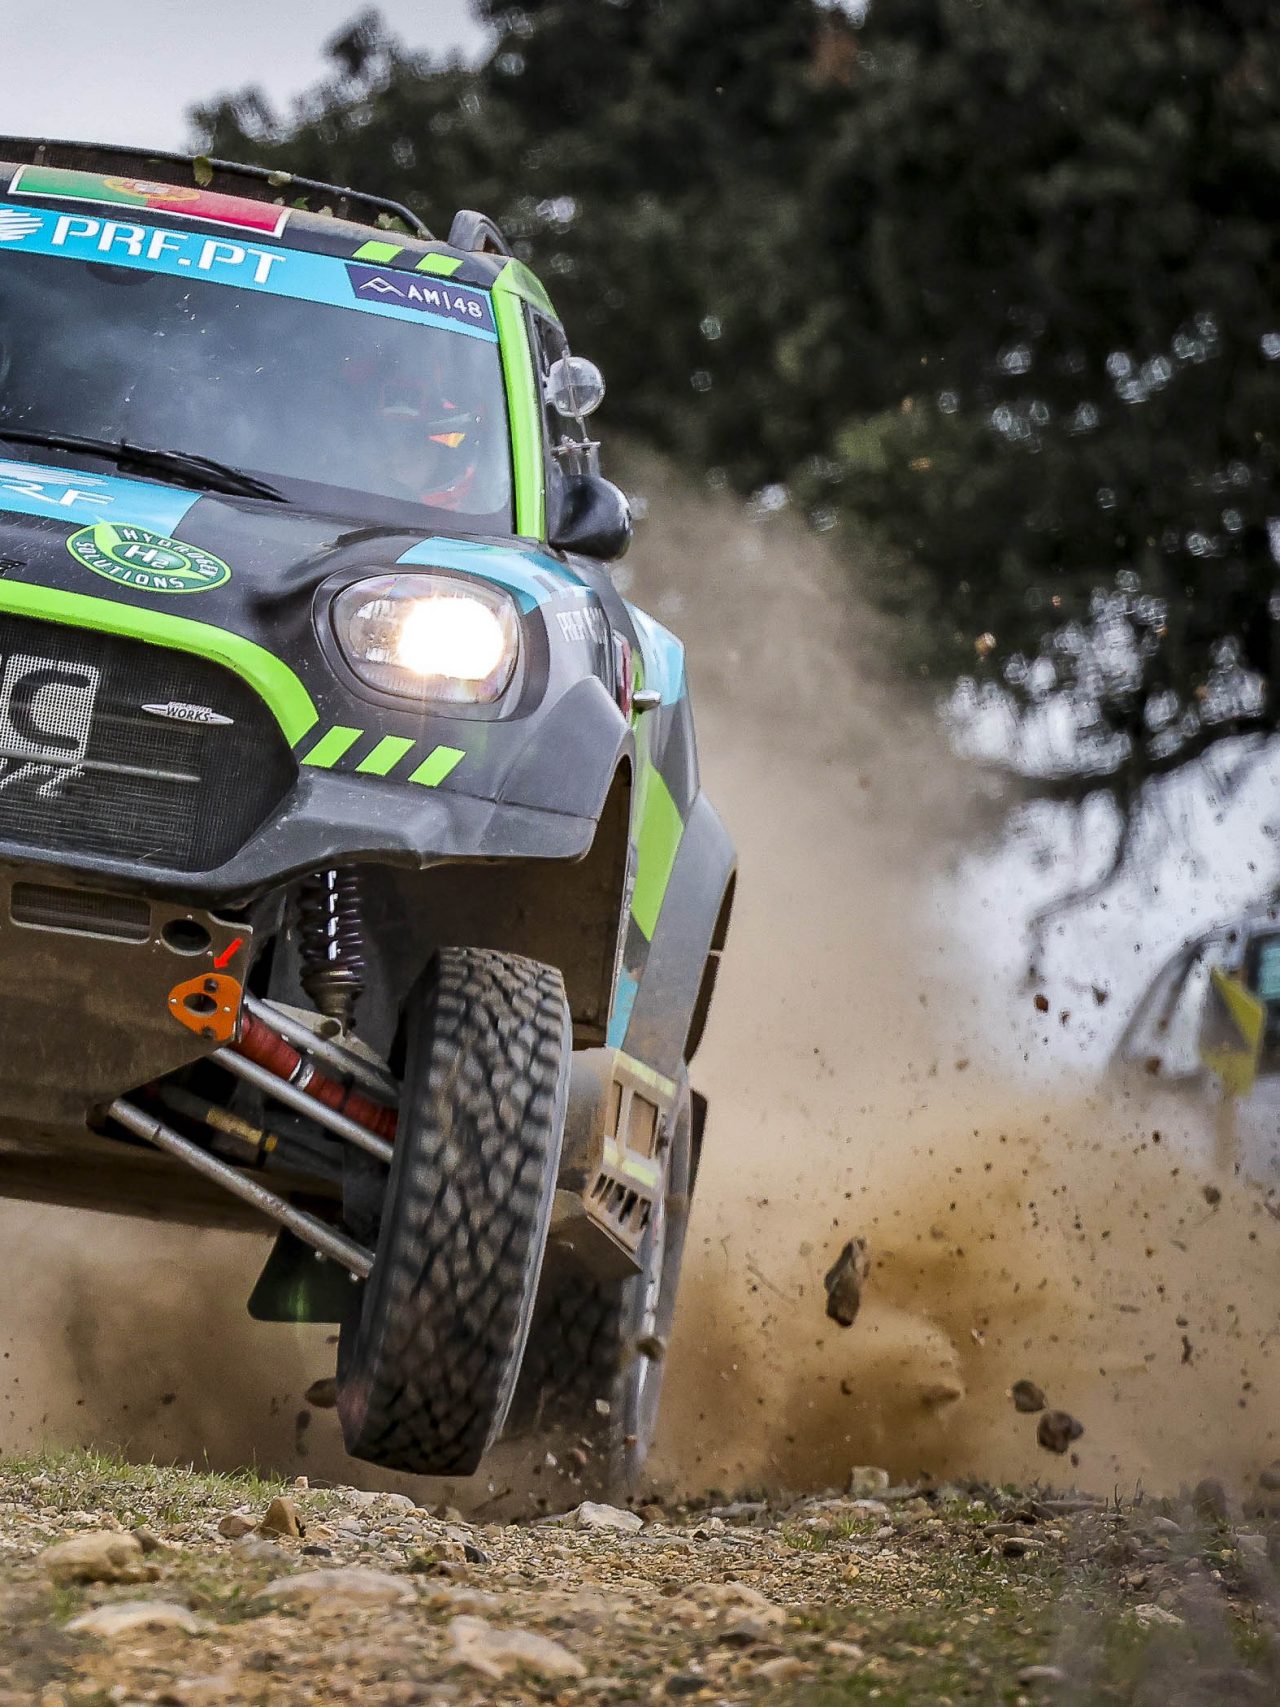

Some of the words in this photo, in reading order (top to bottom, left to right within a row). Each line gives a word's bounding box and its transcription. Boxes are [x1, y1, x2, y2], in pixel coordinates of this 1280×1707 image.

[50, 215, 287, 284] PRF.PT
[75, 541, 185, 589] SOLUTIONS
[124, 544, 171, 569] H2
[166, 706, 212, 721] WORKS
